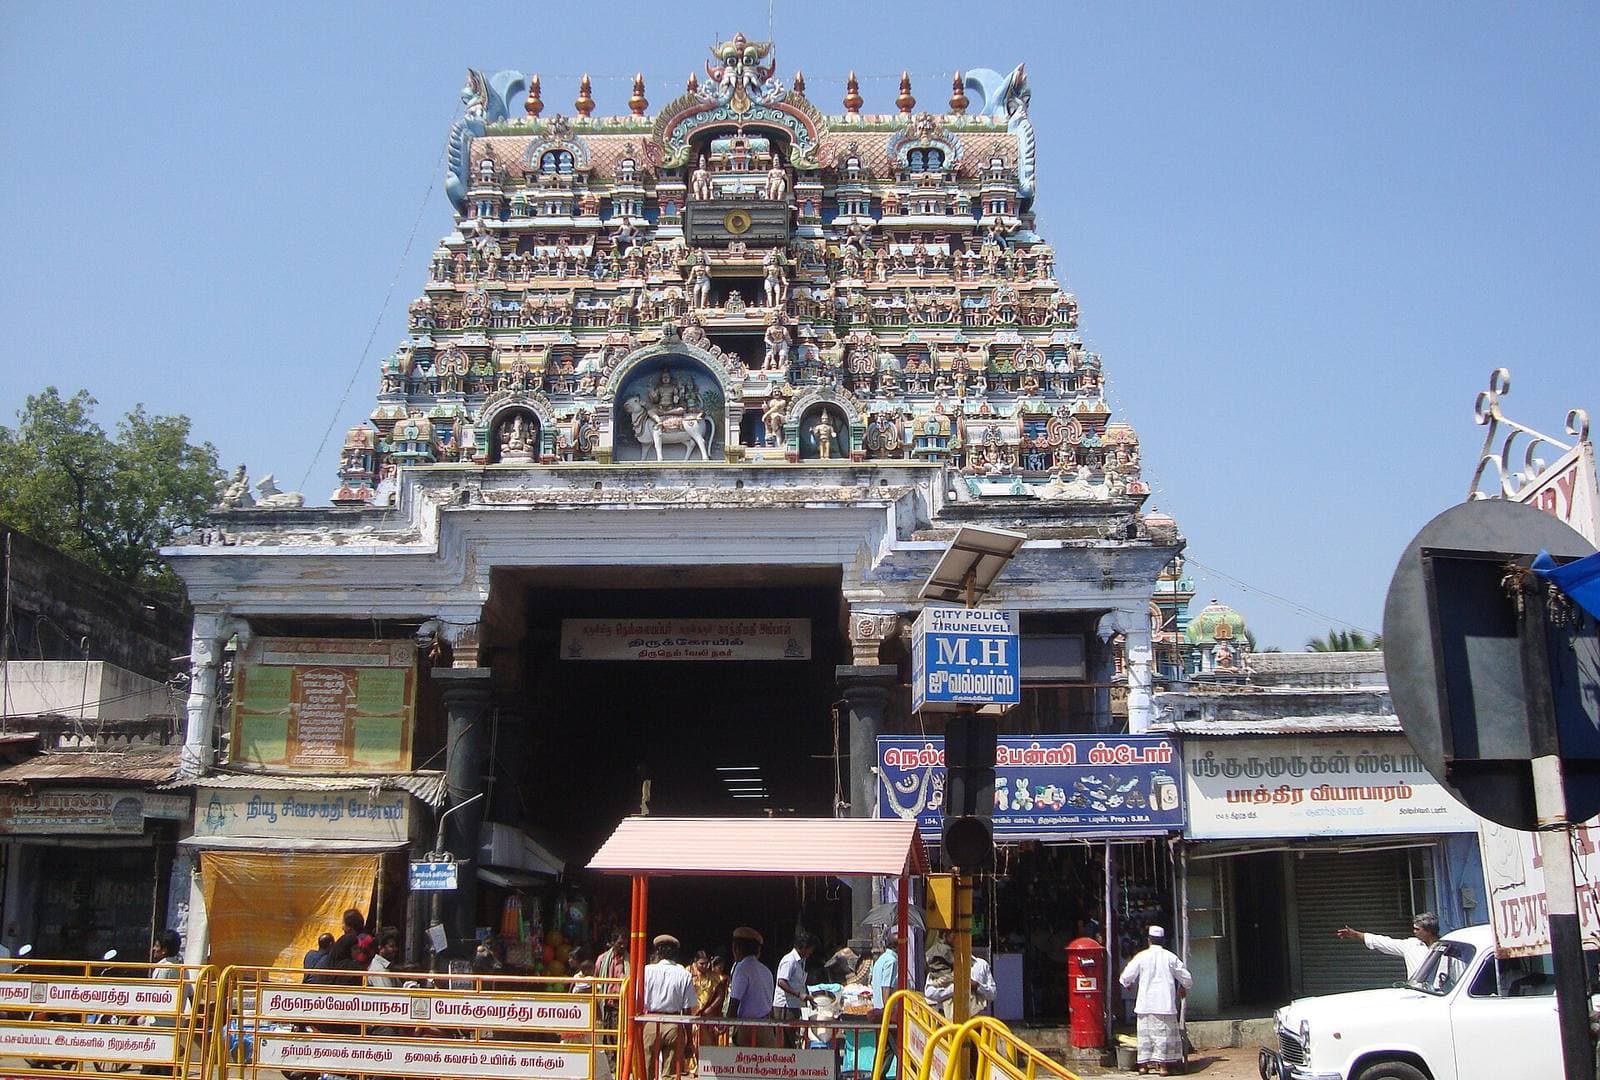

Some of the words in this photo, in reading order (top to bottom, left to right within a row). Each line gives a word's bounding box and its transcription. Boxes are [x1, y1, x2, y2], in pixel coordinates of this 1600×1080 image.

[933, 610, 962, 619] CITY
[966, 611, 1010, 621] POLICE
[932, 622, 1010, 632] TIRUNELVELI
[628, 638, 744, 649] திருக்கோயில்
[935, 638, 1009, 666] M.H
[1088, 740, 1173, 765] ஸ்டோர்
[1226, 783, 1304, 805] பாத்திர
[1310, 780, 1413, 802] வியாபாரம்
[246, 794, 278, 823] நியூ
[281, 795, 345, 822] சிவசக்தி
[49, 985, 130, 1006] போக்குவரத்து
[135, 989, 173, 1004] காவல்
[270, 993, 361, 1015] திருநெல்வேலி
[434, 1000, 534, 1024] போக்குவரத்து
[537, 1004, 582, 1021] காவல்
[55, 1034, 105, 1048] இடங்களில்
[281, 1043, 312, 1058] தர்மம்
[312, 1045, 350, 1059] தலைக்
[351, 1046, 393, 1062] காக்கும்
[404, 1048, 442, 1064] தலைக்
[444, 1050, 478, 1065] கவசம்
[480, 1051, 517, 1067] உயிர்க்
[520, 1053, 565, 1070] காக்கும்
[735, 1051, 796, 1064] திருநெல்வேலி
[737, 1063, 798, 1077] போக்குவரத்து
[799, 1065, 829, 1077] காவல்
